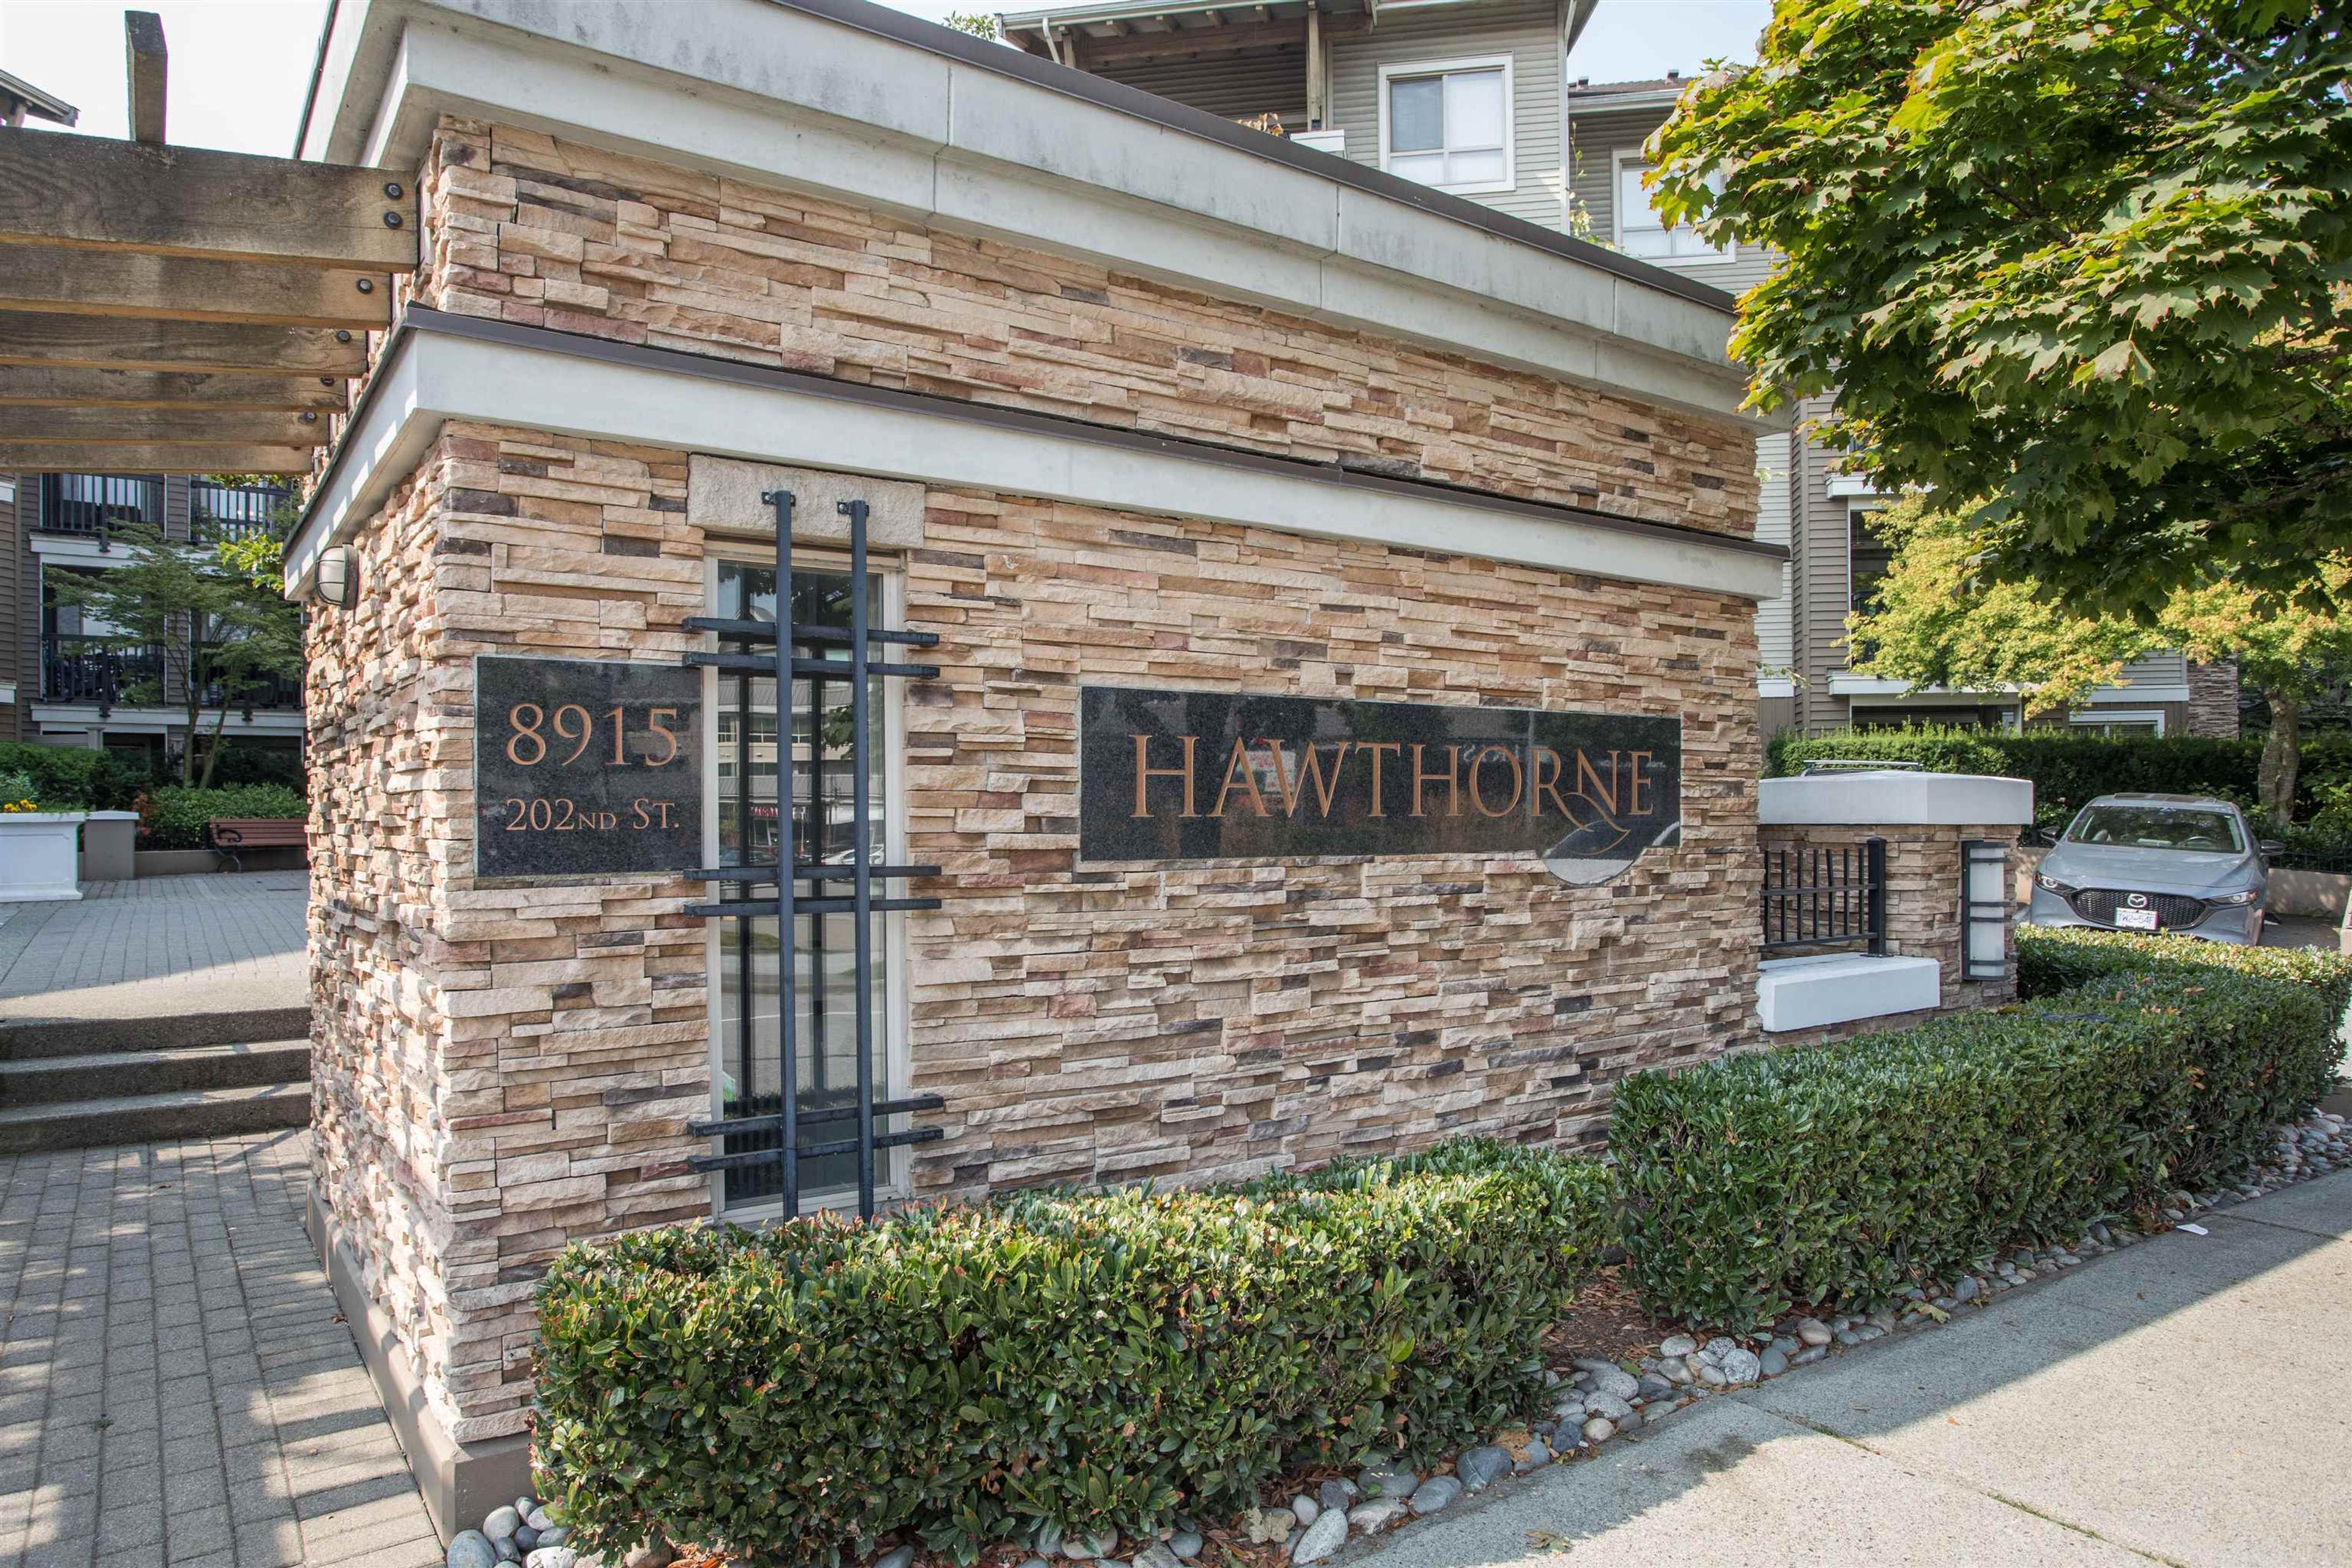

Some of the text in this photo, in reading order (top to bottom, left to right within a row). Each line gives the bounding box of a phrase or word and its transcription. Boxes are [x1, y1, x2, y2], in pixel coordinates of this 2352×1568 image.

[506, 703, 677, 766] 8915
[505, 797, 680, 831] 202ND ST.
[1128, 734, 1653, 832] HAWTHORNE
